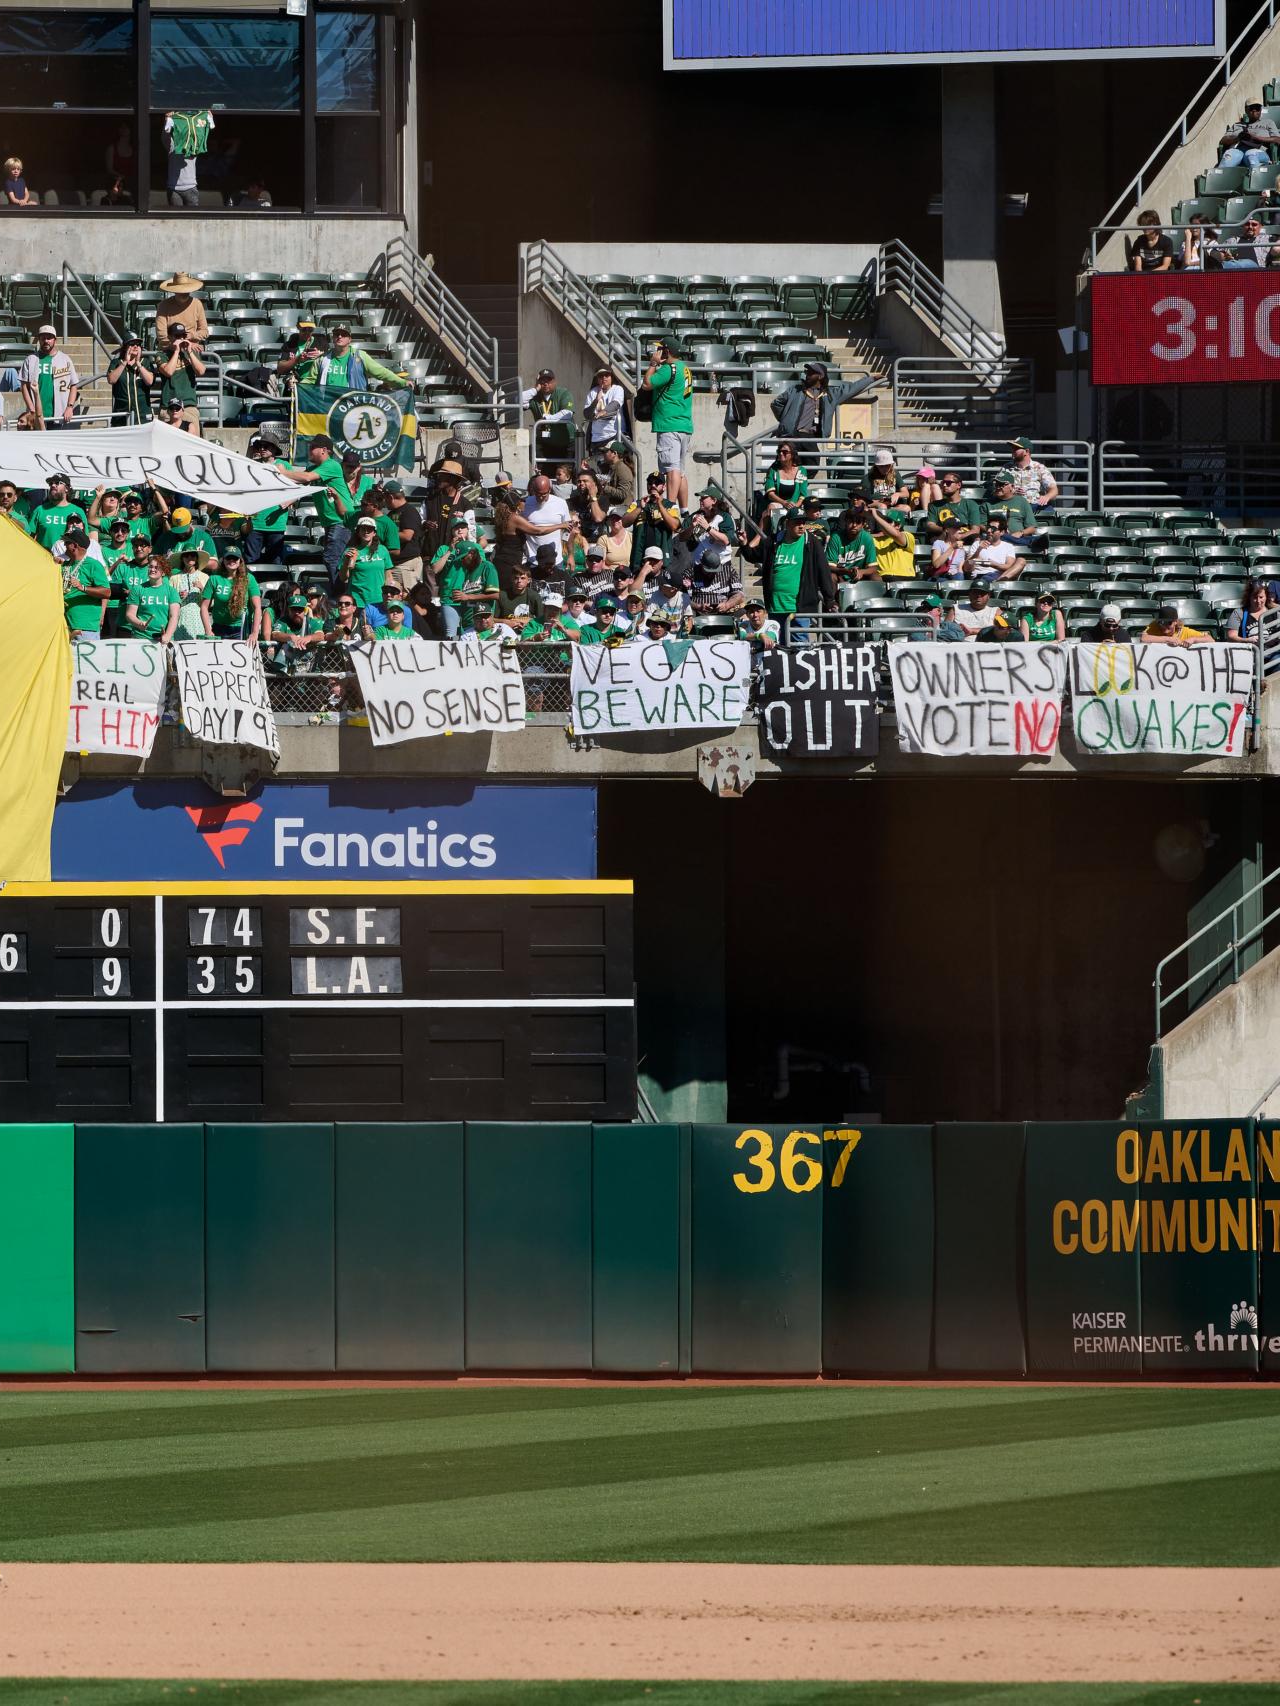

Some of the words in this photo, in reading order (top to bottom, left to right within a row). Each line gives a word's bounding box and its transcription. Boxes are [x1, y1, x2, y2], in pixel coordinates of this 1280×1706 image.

[338, 396, 393, 413] OAKLAND
[34, 453, 178, 488] NEVER
[176, 453, 292, 486] QUIT
[45, 514, 67, 525] SEL
[141, 595, 169, 606] SELL
[439, 641, 521, 675] MAKE
[576, 641, 736, 685] VEGAS
[758, 647, 876, 695] FISHER
[895, 645, 1064, 698] OWNERS
[77, 679, 135, 705] REAL
[368, 699, 415, 738] NO
[424, 684, 525, 729] SENSE
[577, 684, 741, 730] BEWARE
[187, 706, 244, 742] DAY!
[764, 700, 871, 751] OUT
[904, 700, 1010, 749] VOTE
[1014, 698, 1060, 753] NO
[1077, 697, 1245, 753] QUAKES!
[274, 818, 497, 868] Fanatics
[101, 908, 121, 947] 0
[198, 908, 253, 946] 74
[307, 908, 386, 945] S.F.
[0, 933, 18, 972] 6
[102, 957, 122, 996] 9
[196, 956, 254, 994] 35
[306, 956, 388, 994] L.A.
[732, 1129, 862, 1193] 367
[1116, 1129, 1280, 1184] OAKLAN
[1072, 1312, 1127, 1329] KAISER
